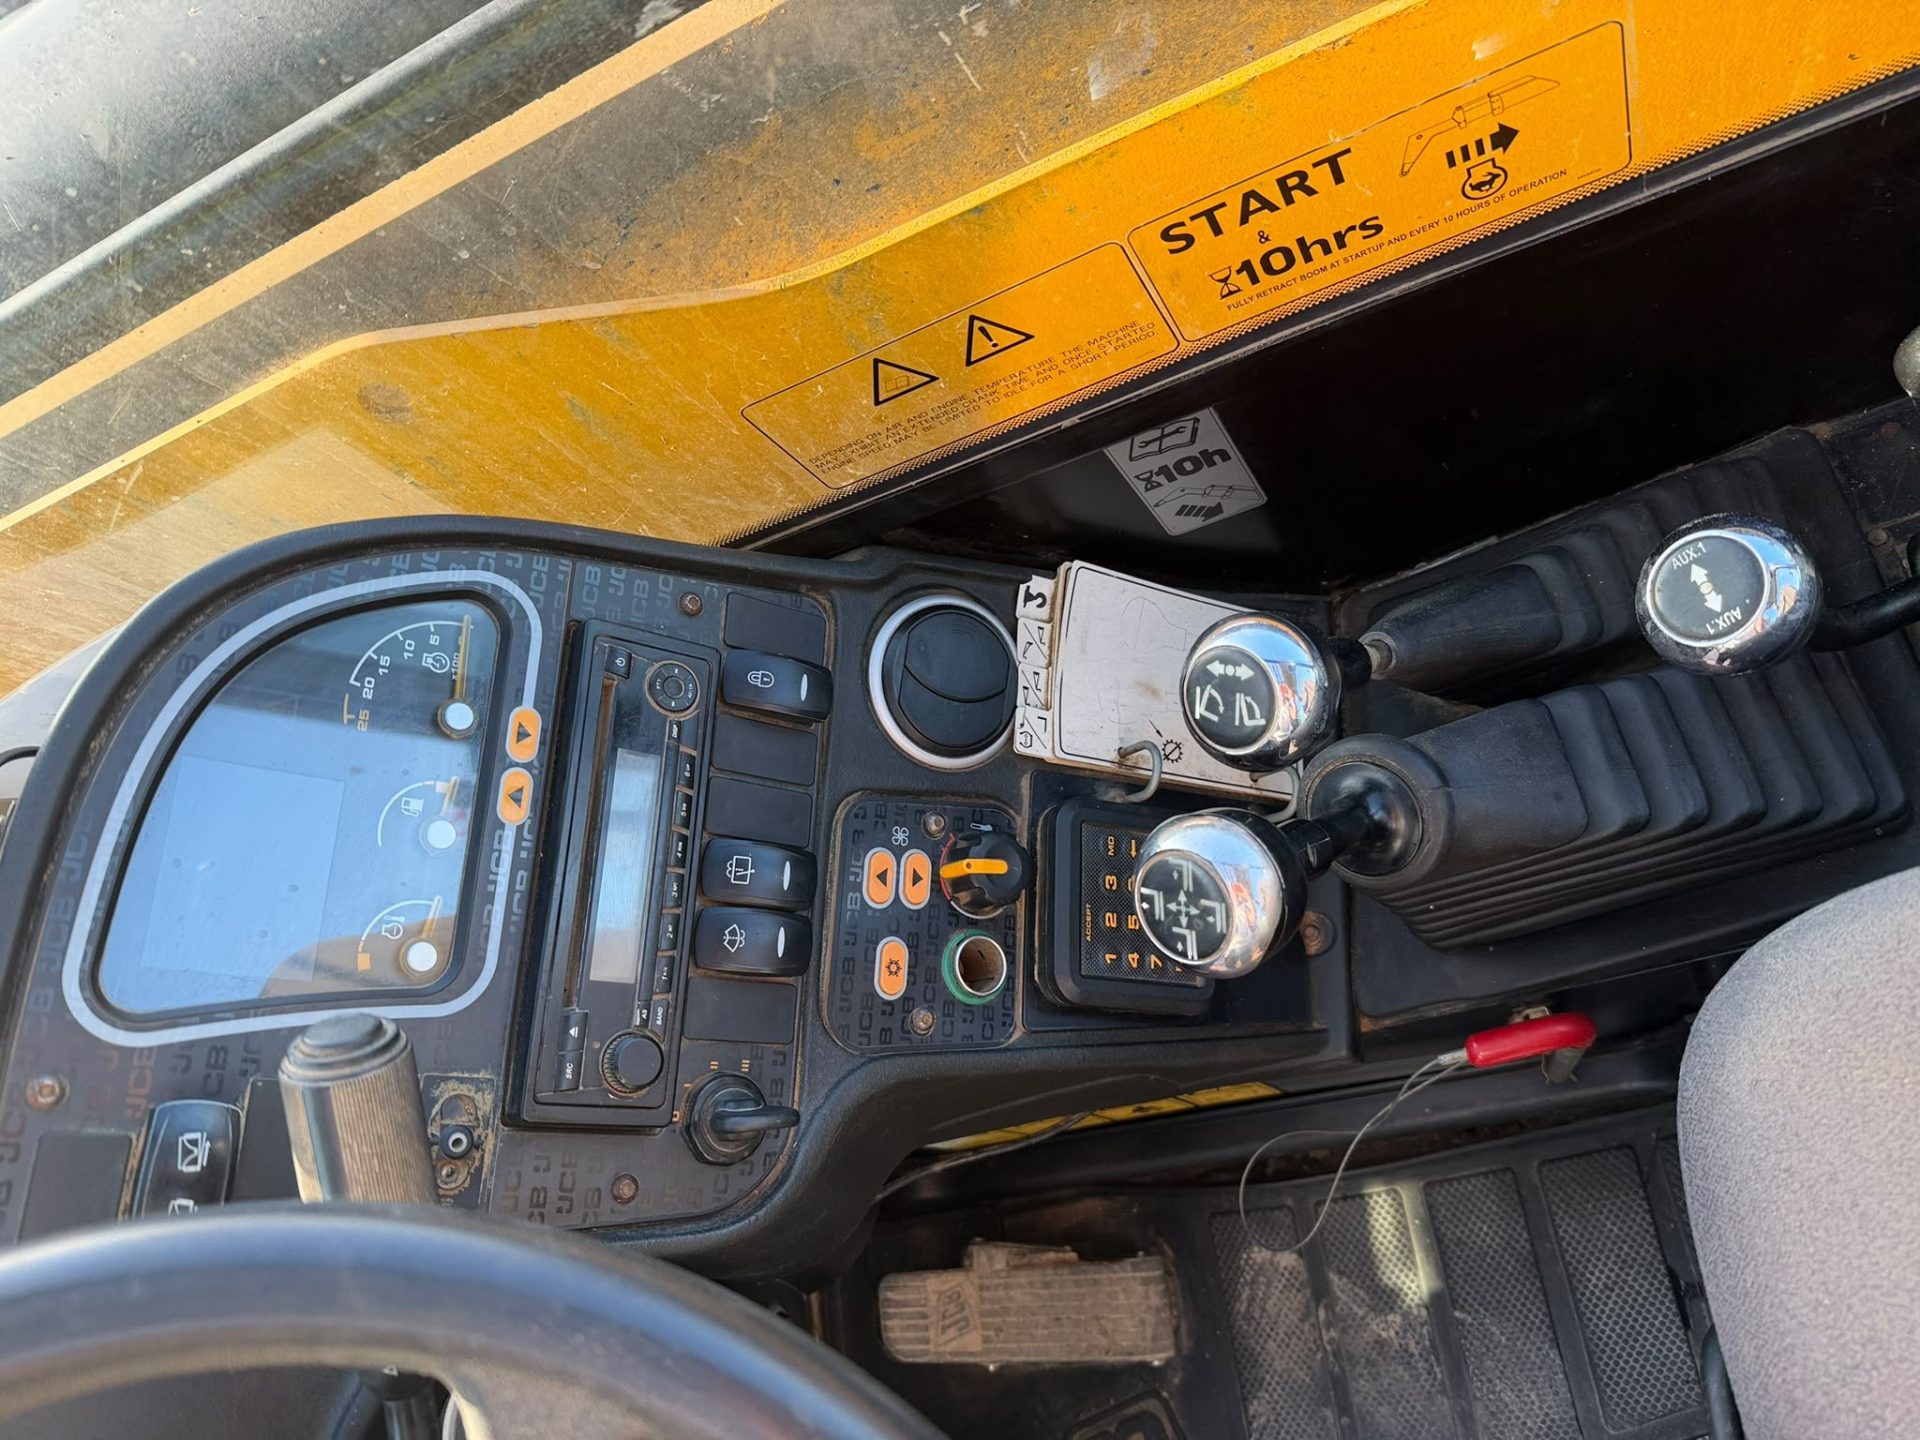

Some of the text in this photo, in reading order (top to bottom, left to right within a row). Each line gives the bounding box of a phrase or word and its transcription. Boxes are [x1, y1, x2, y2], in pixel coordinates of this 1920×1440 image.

[1159, 147, 1352, 255] START
[1227, 295, 1255, 312] FULLY
[1255, 278, 1298, 300] RETRACT
[1300, 265, 1329, 282] BOOM
[1329, 260, 1341, 270] AT
[1342, 243, 1385, 264] STARTUP
[1388, 234, 1408, 248] AND
[1409, 219, 1441, 238] EVERY
[1443, 214, 1454, 224] 10
[1456, 200, 1491, 218] HOURS
[1493, 193, 1507, 204] OF
[1508, 169, 1568, 197] OPERATION
[1257, 230, 1272, 244] &
[1235, 215, 1384, 286] 10hrs
[809, 320, 1141, 464] DEPENDING ON AIR AND ENGINE TEMPERATURE THE MACHINE
[815, 321, 1156, 469] MAY EXHIBIT AN EXTENDED CRANK TIME AND ONCE STARTED
[820, 455, 856, 474] ENGINE
[859, 442, 892, 459] SPEED
[894, 430, 919, 445] MAY
[922, 424, 939, 433] BE
[940, 405, 982, 425] LIMITED
[986, 396, 1001, 406] TO
[1004, 384, 1029, 398] IDLE
[1030, 374, 1052, 388] FOR
[1057, 368, 1067, 376] A
[1070, 351, 1109, 370] SHORT
[1154, 448, 1232, 484] 10h
[1671, 541, 1707, 570] AUX.1
[581, 565, 601, 617] JCB
[1705, 605, 1743, 635] AUX.1
[403, 639, 415, 660] 10
[429, 634, 440, 646] 5
[378, 655, 391, 676] 15
[362, 677, 376, 700] 20
[357, 708, 370, 732] 25
[1105, 875, 1117, 890] 3
[1105, 912, 1117, 928] 2
[1128, 915, 1140, 930] 5
[1104, 953, 1117, 964] 1
[1128, 952, 1140, 968] 4
[1150, 954, 1163, 969] 7
[203, 1044, 229, 1096] CB
[565, 1062, 573, 1080] SRC
